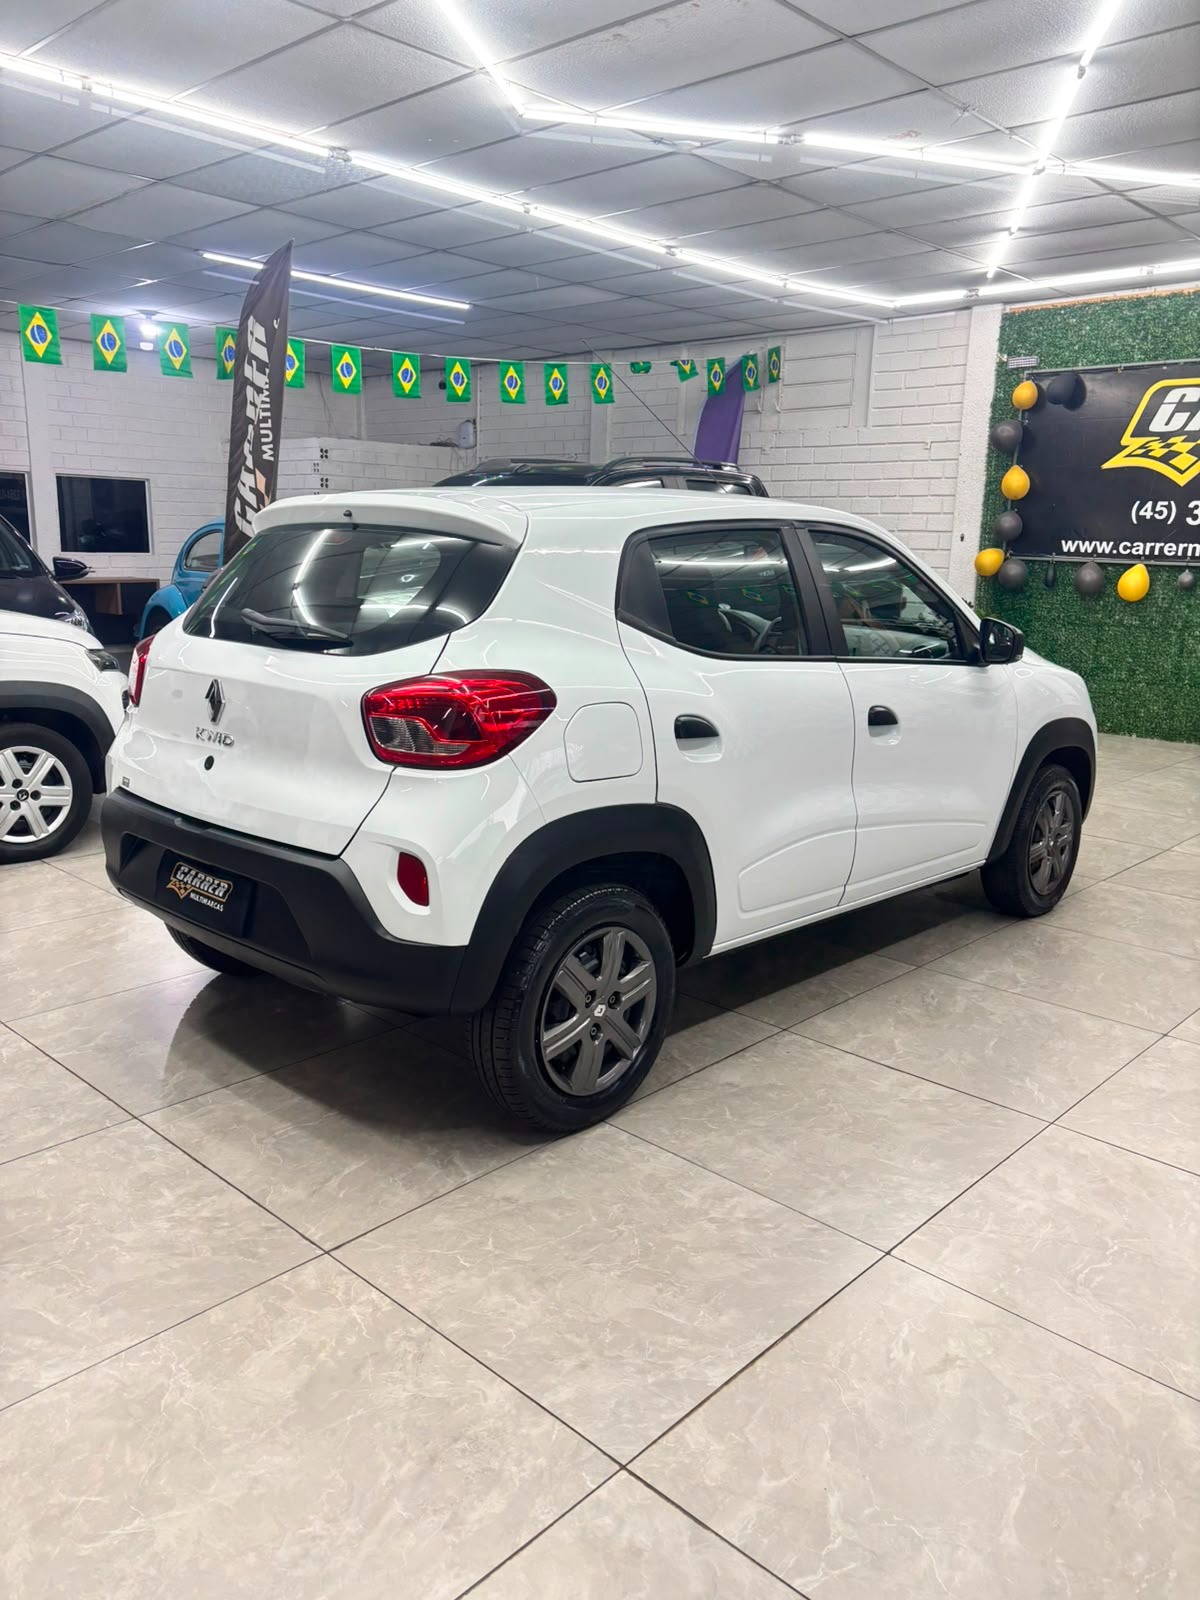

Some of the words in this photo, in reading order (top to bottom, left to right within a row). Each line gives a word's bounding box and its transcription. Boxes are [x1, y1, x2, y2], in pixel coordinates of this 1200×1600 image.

[1131, 500, 1177, 525] (45)
[196, 726, 235, 748] KWID
[176, 866, 228, 897] CARRER
